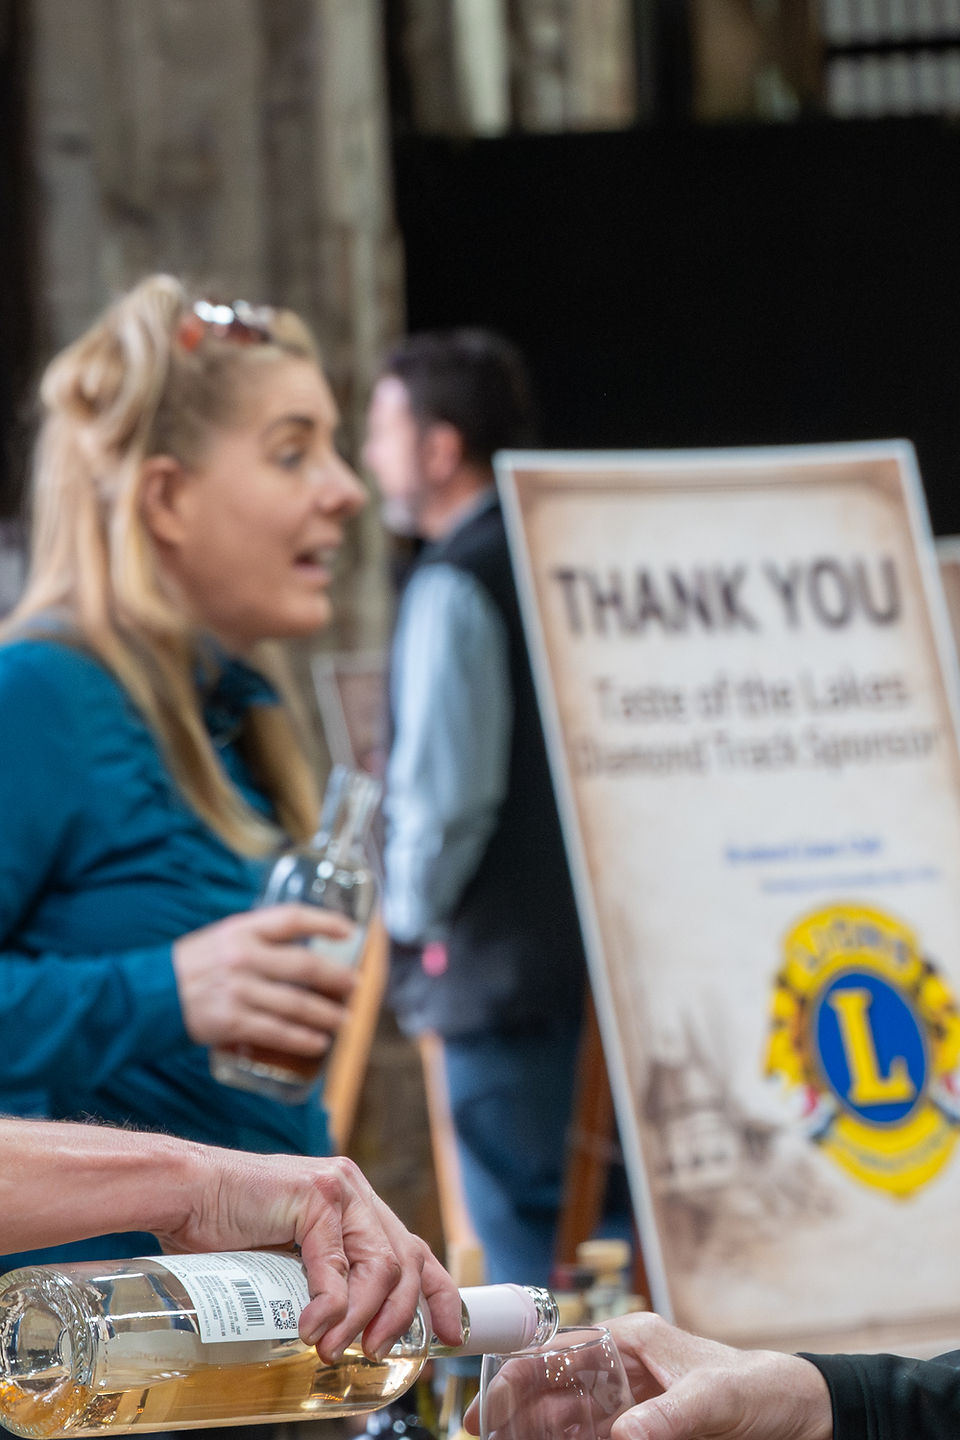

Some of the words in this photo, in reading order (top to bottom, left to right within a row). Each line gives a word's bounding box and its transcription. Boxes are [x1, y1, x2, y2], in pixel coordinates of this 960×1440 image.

[551, 562, 759, 636] THANK
[762, 556, 902, 631] YOU
[831, 988, 913, 1104] L
